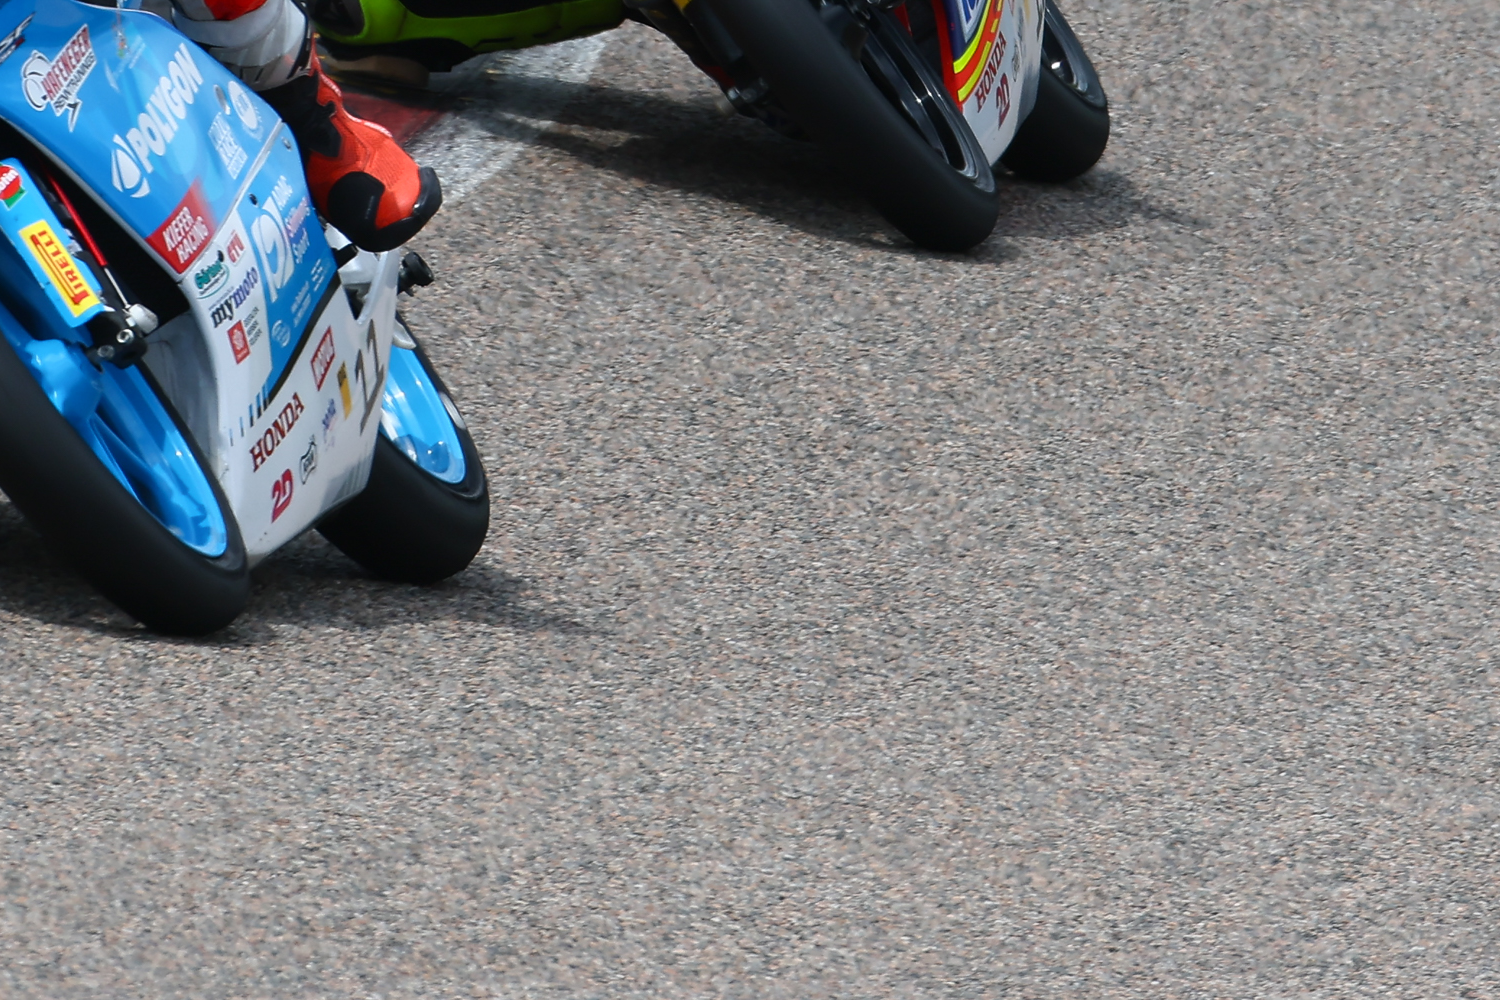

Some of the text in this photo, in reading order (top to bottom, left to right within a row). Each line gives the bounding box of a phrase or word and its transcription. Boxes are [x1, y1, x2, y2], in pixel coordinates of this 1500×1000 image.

[40, 27, 93, 100] HAFENEGER
[974, 31, 1007, 113] HONDA
[126, 43, 204, 174] POLYGON
[162, 206, 195, 252] KIEFER
[174, 215, 209, 264] RACING
[30, 230, 90, 306] PIRELLI
[211, 267, 259, 328] mymoto
[249, 392, 304, 473] HONDA
